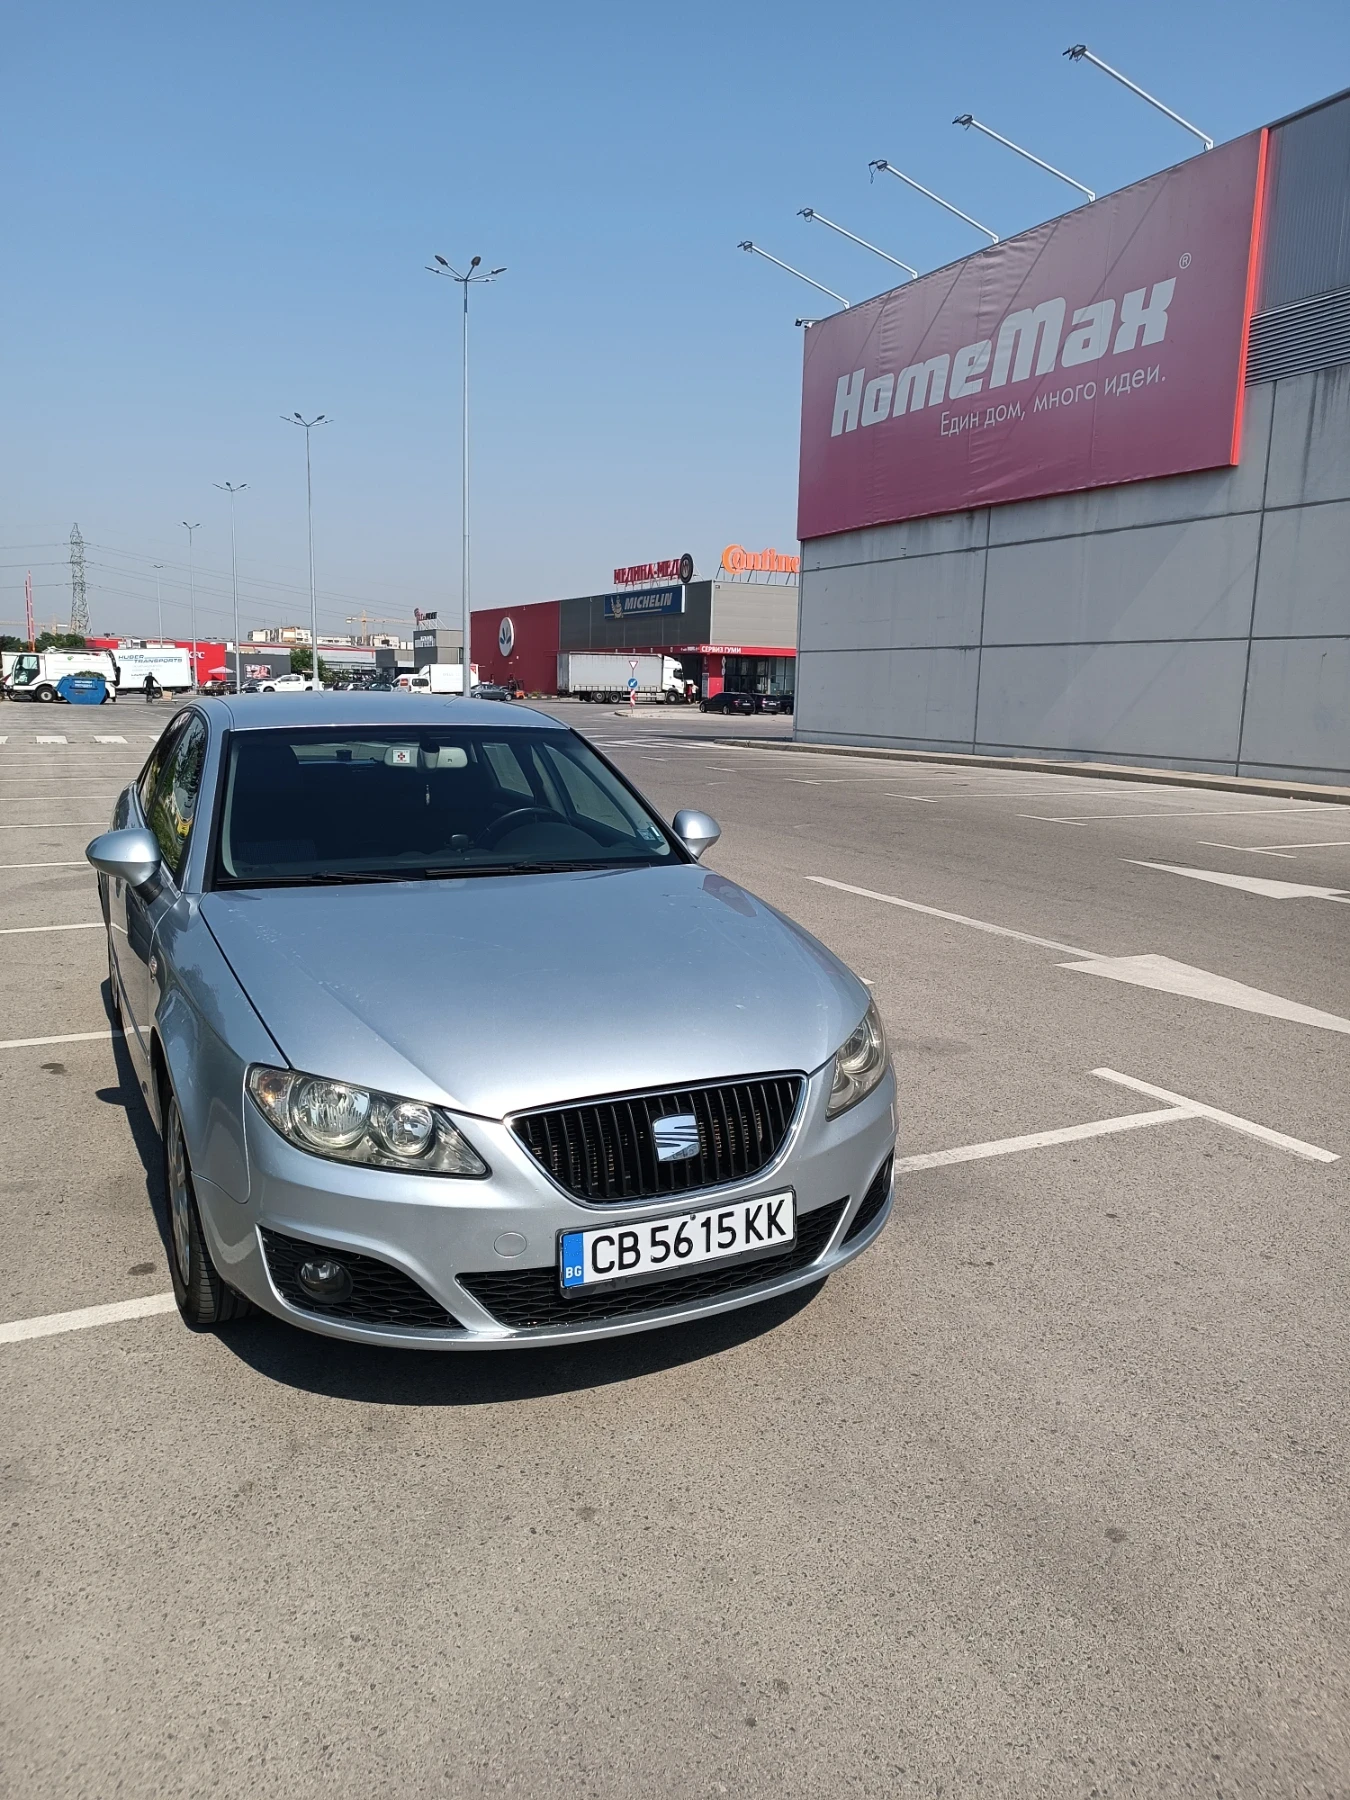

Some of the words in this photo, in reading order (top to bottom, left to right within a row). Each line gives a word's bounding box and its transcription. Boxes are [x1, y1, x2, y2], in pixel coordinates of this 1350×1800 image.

[831, 277, 1177, 438] HomeMax
[940, 410, 979, 438] Един
[984, 400, 1027, 428] дом,
[1033, 381, 1097, 413] много
[1104, 363, 1167, 398] идеи.
[624, 592, 673, 610] MICHELIN
[701, 645, 724, 654] СЕРВИЗ
[724, 646, 742, 655] ГУМИ
[650, 1210, 737, 1264] 5615
[565, 1265, 582, 1279] BG
